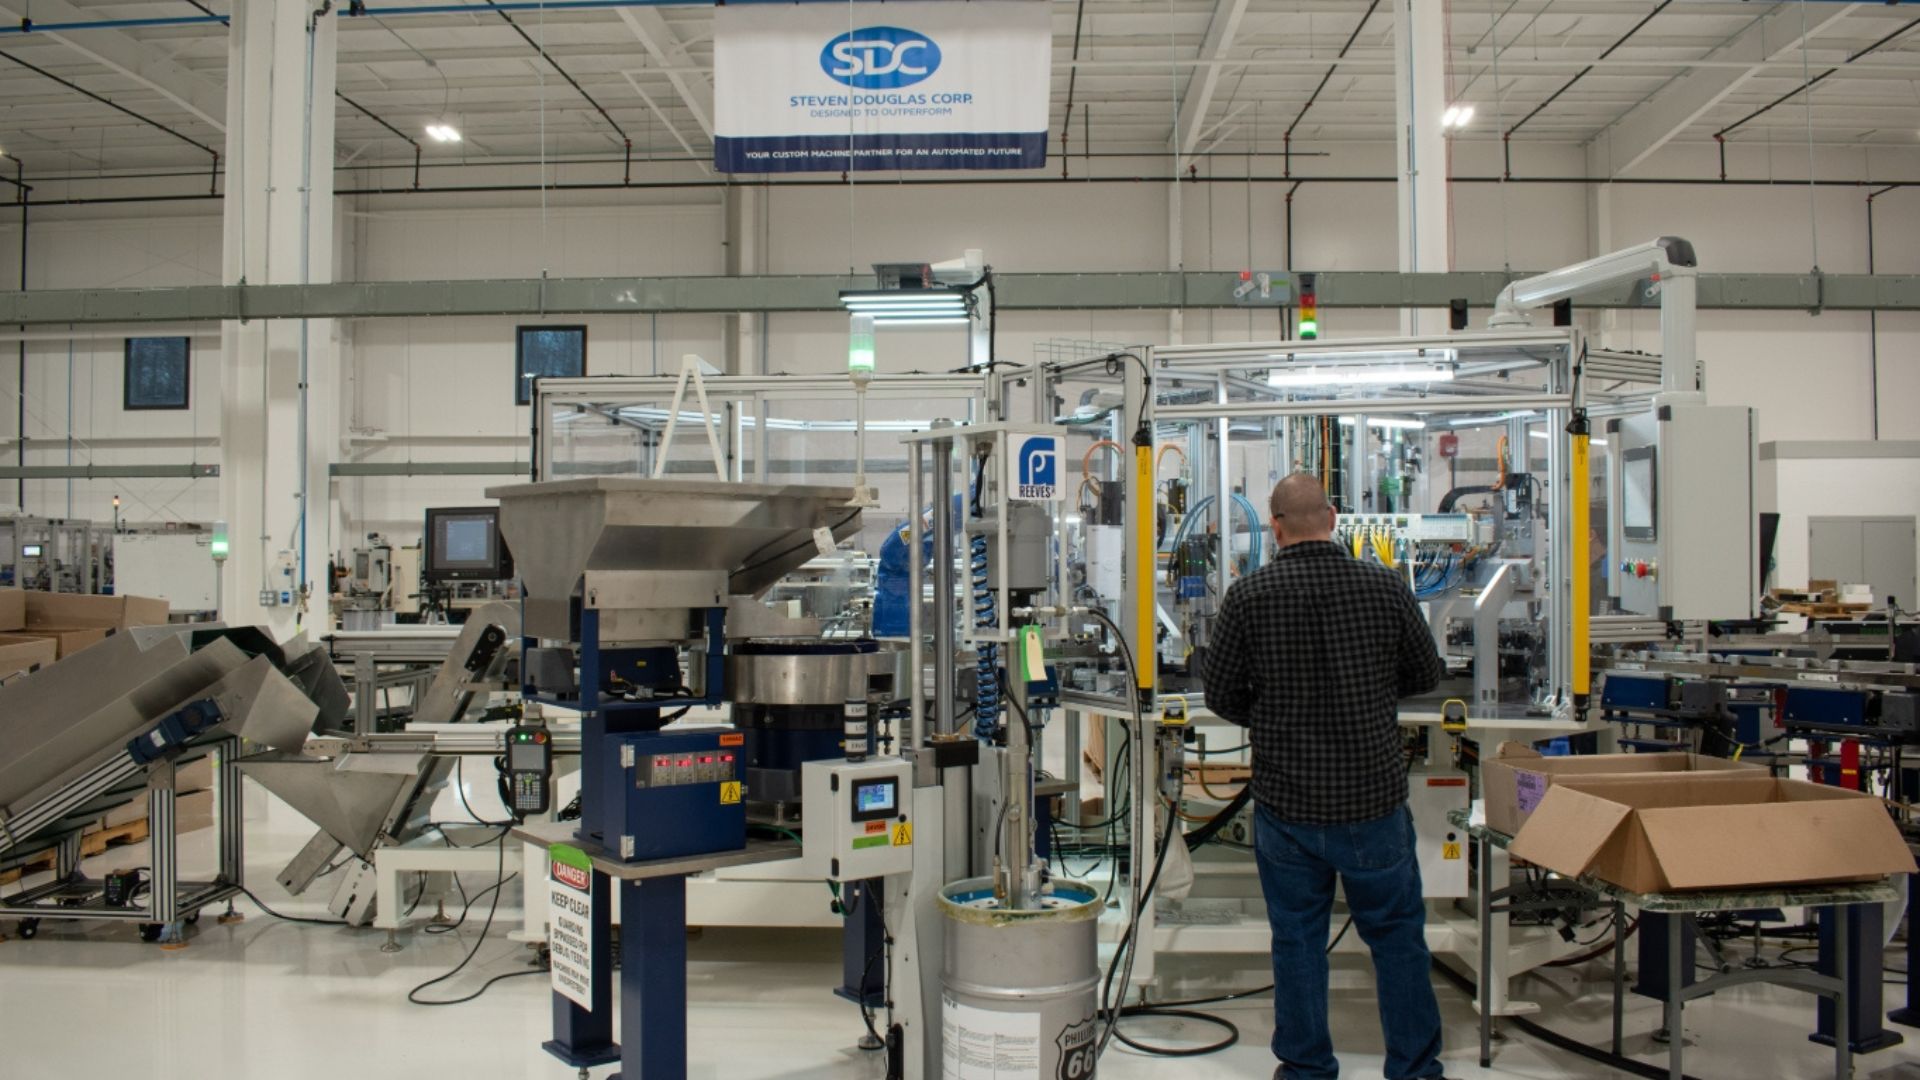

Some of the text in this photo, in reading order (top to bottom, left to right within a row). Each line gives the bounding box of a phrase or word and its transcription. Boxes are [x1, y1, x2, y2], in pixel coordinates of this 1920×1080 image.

[832, 40, 928, 77] SDC
[790, 93, 973, 107] STEVEN DOUGLAS CORP.
[810, 107, 952, 118] DESIGNED TO OUTPERFORM
[746, 147, 1022, 159] YOUR CUSTOM MACHINE PARTNER FOR AN AUTOMATED FUTURE
[1019, 485, 1051, 498] REEVES
[556, 862, 586, 885] DANGER
[551, 891, 589, 918] KEEP CLEAR
[1067, 1044, 1095, 1079] 66
